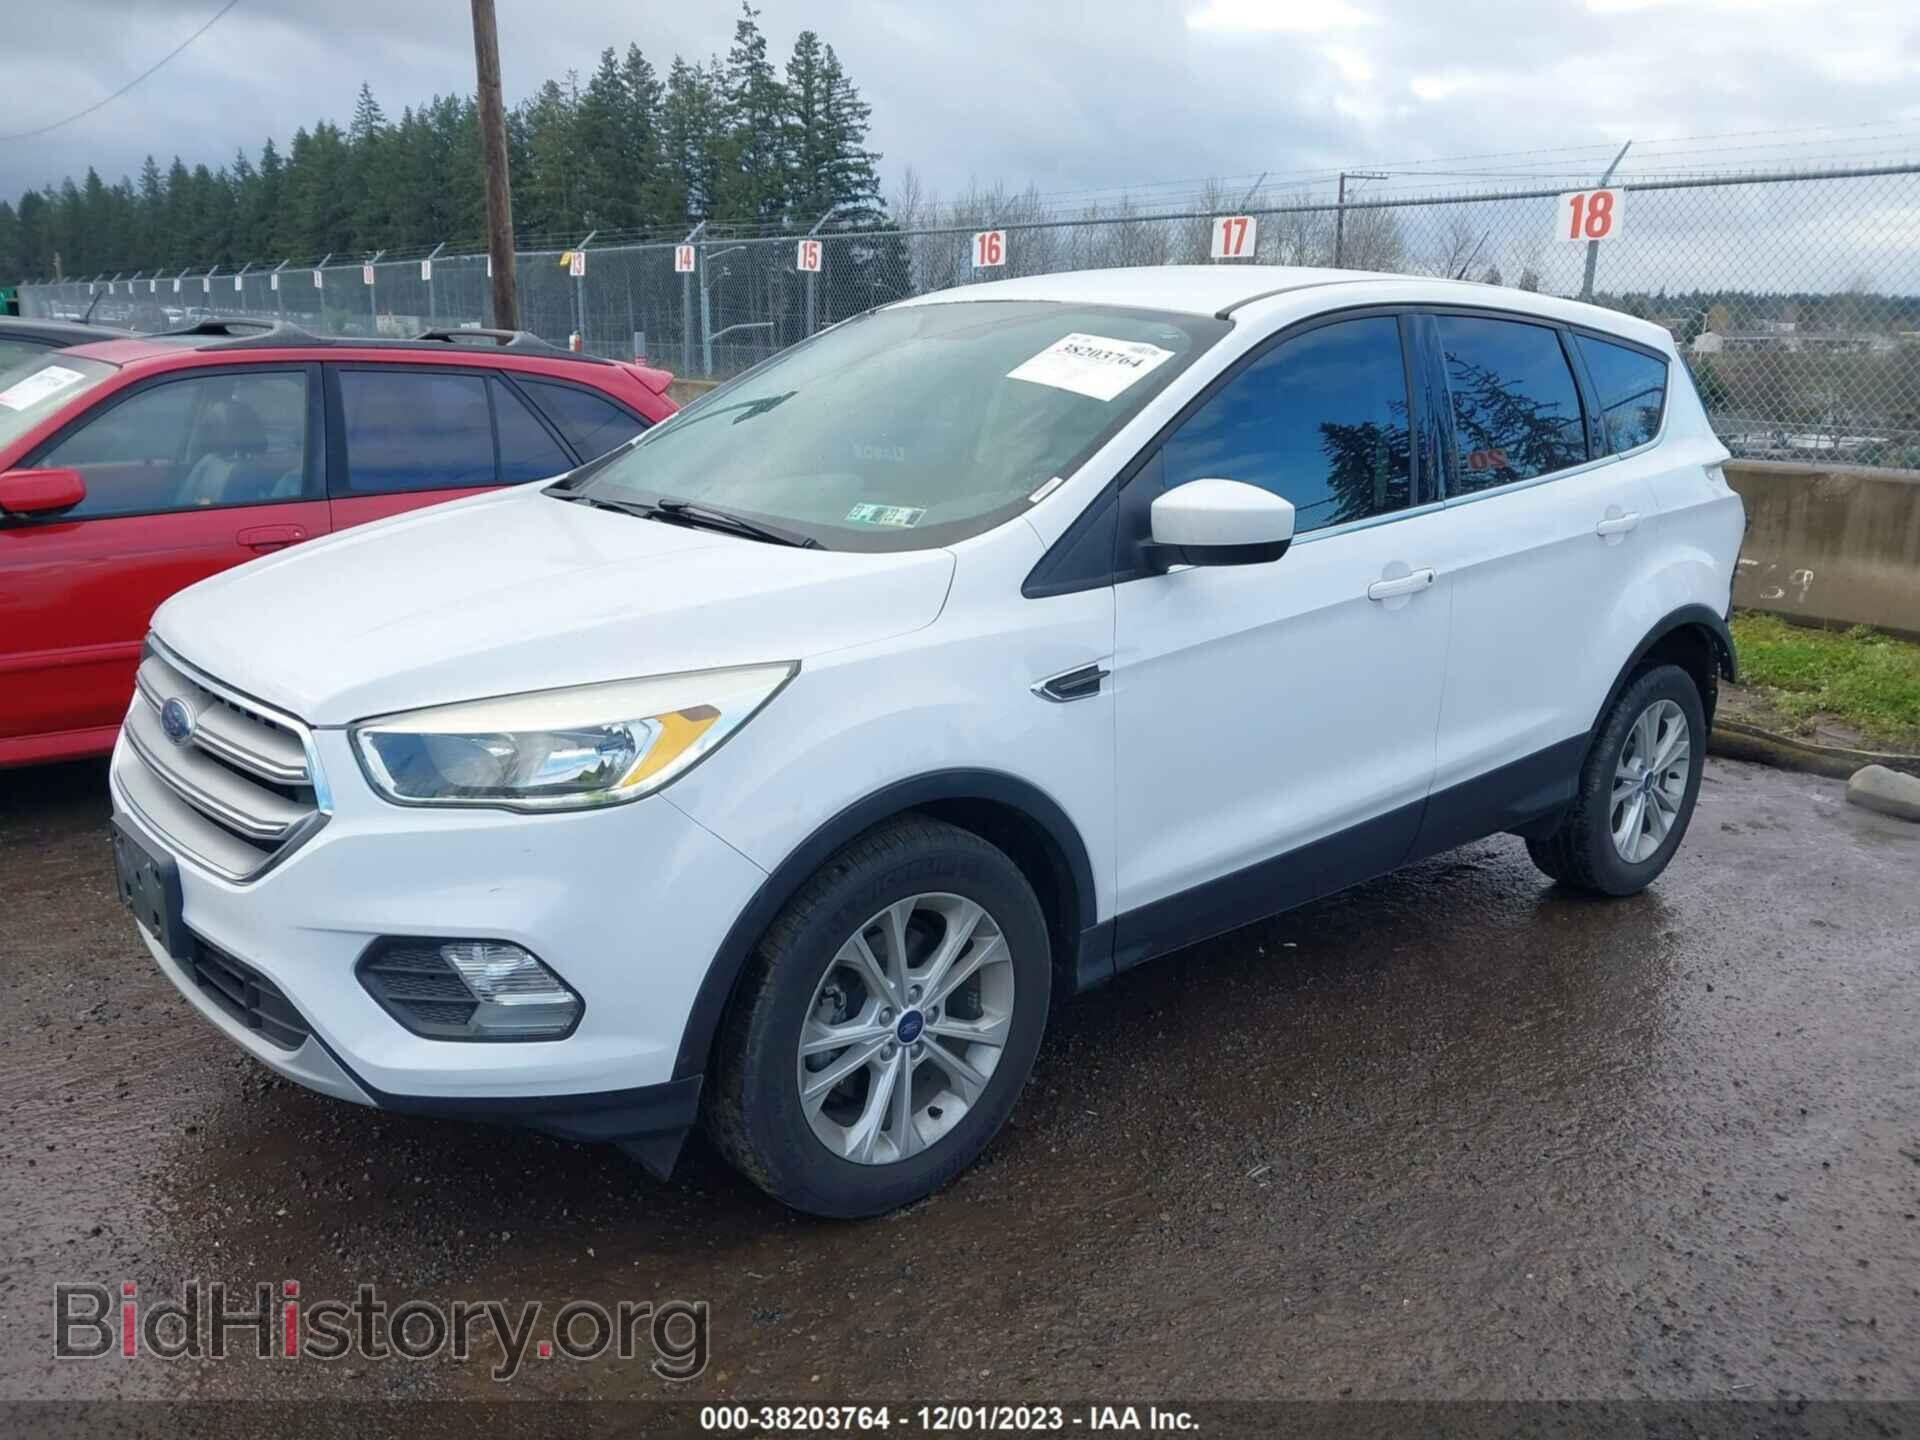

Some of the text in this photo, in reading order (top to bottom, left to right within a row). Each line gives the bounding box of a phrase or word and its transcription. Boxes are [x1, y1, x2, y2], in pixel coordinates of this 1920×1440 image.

[1569, 191, 1614, 239] 18
[977, 232, 1001, 265] 16
[1221, 218, 1248, 256] 17
[572, 253, 583, 274] 13
[678, 246, 692, 270] 14
[801, 242, 818, 270] 15
[1063, 343, 1145, 368] 38203764
